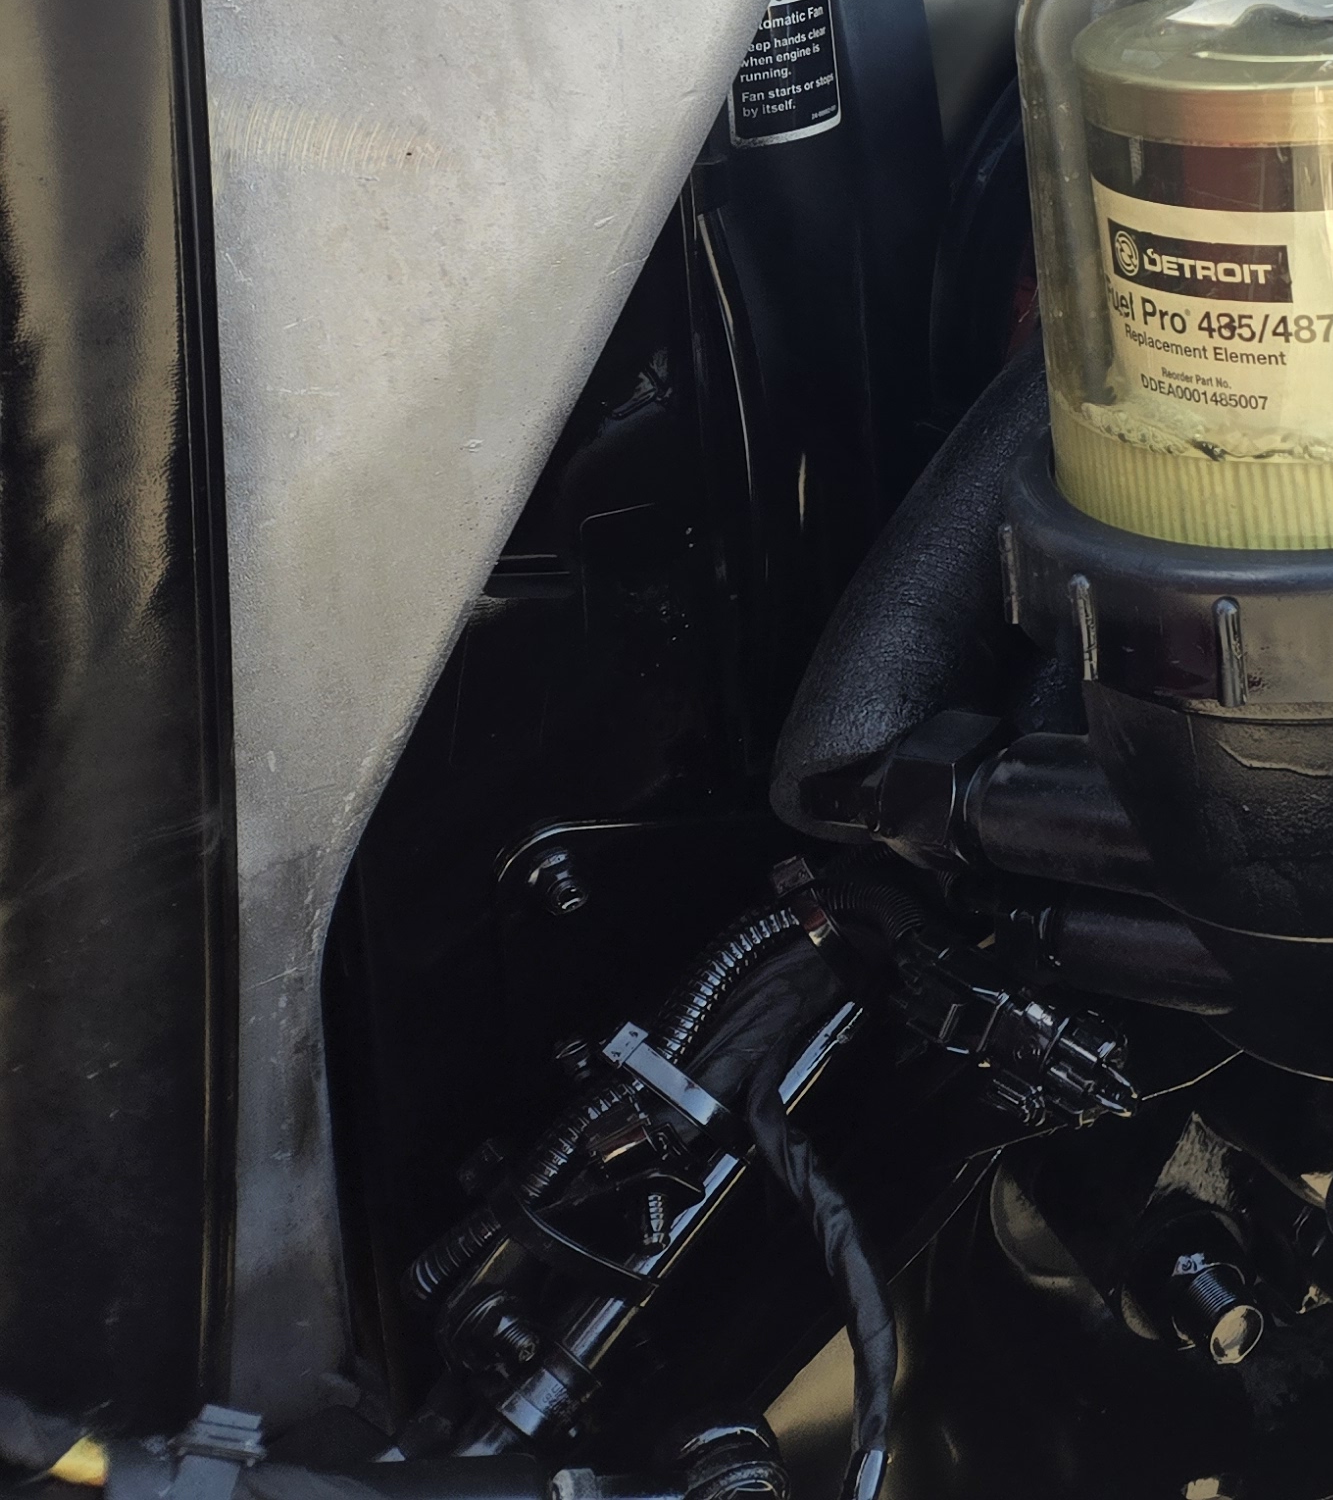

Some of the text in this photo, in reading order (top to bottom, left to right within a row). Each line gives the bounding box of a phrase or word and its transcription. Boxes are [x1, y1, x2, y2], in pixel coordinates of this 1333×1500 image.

[808, 5, 824, 20] Fan
[748, 26, 826, 53] eep hands clear
[741, 43, 820, 68] when engine is
[740, 66, 792, 83] running.
[741, 72, 834, 103] Fan starts or stops
[742, 106, 758, 118] by
[1143, 248, 1272, 285] DETROIT
[1125, 323, 1287, 366] Replacement Element
[1161, 366, 1232, 389] Reorder Part No.
